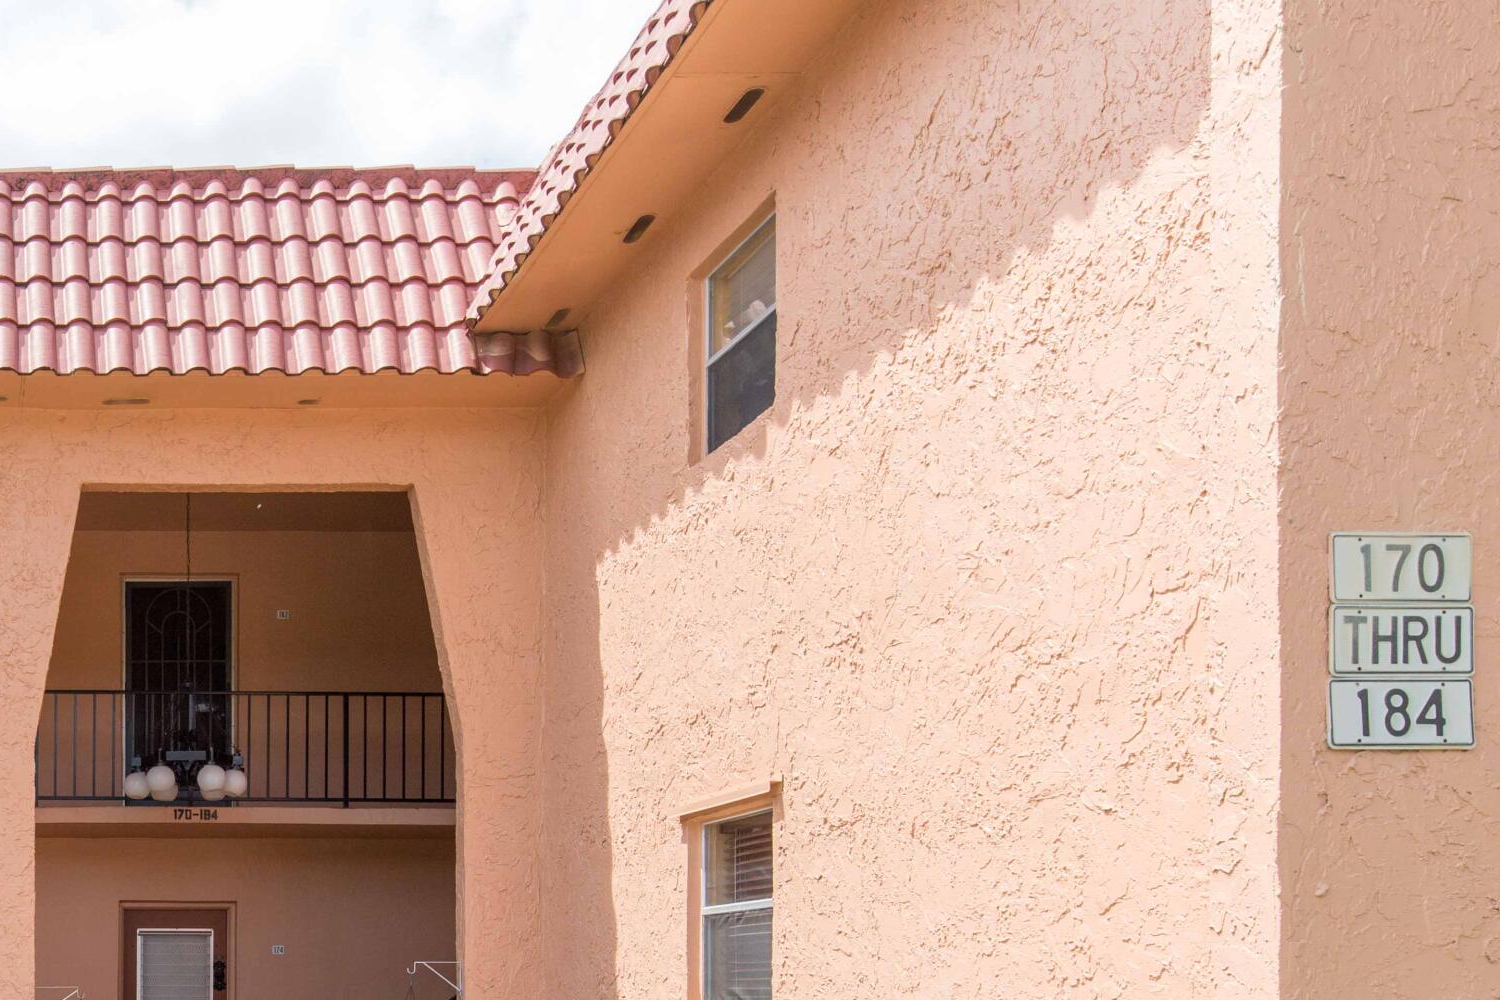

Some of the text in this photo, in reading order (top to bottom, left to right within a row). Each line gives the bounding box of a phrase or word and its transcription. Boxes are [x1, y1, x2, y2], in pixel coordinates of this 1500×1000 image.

[1360, 543, 1445, 593] 170
[1343, 615, 1462, 665] THRU
[1357, 688, 1447, 737] 184
[173, 808, 218, 821] 170-184
